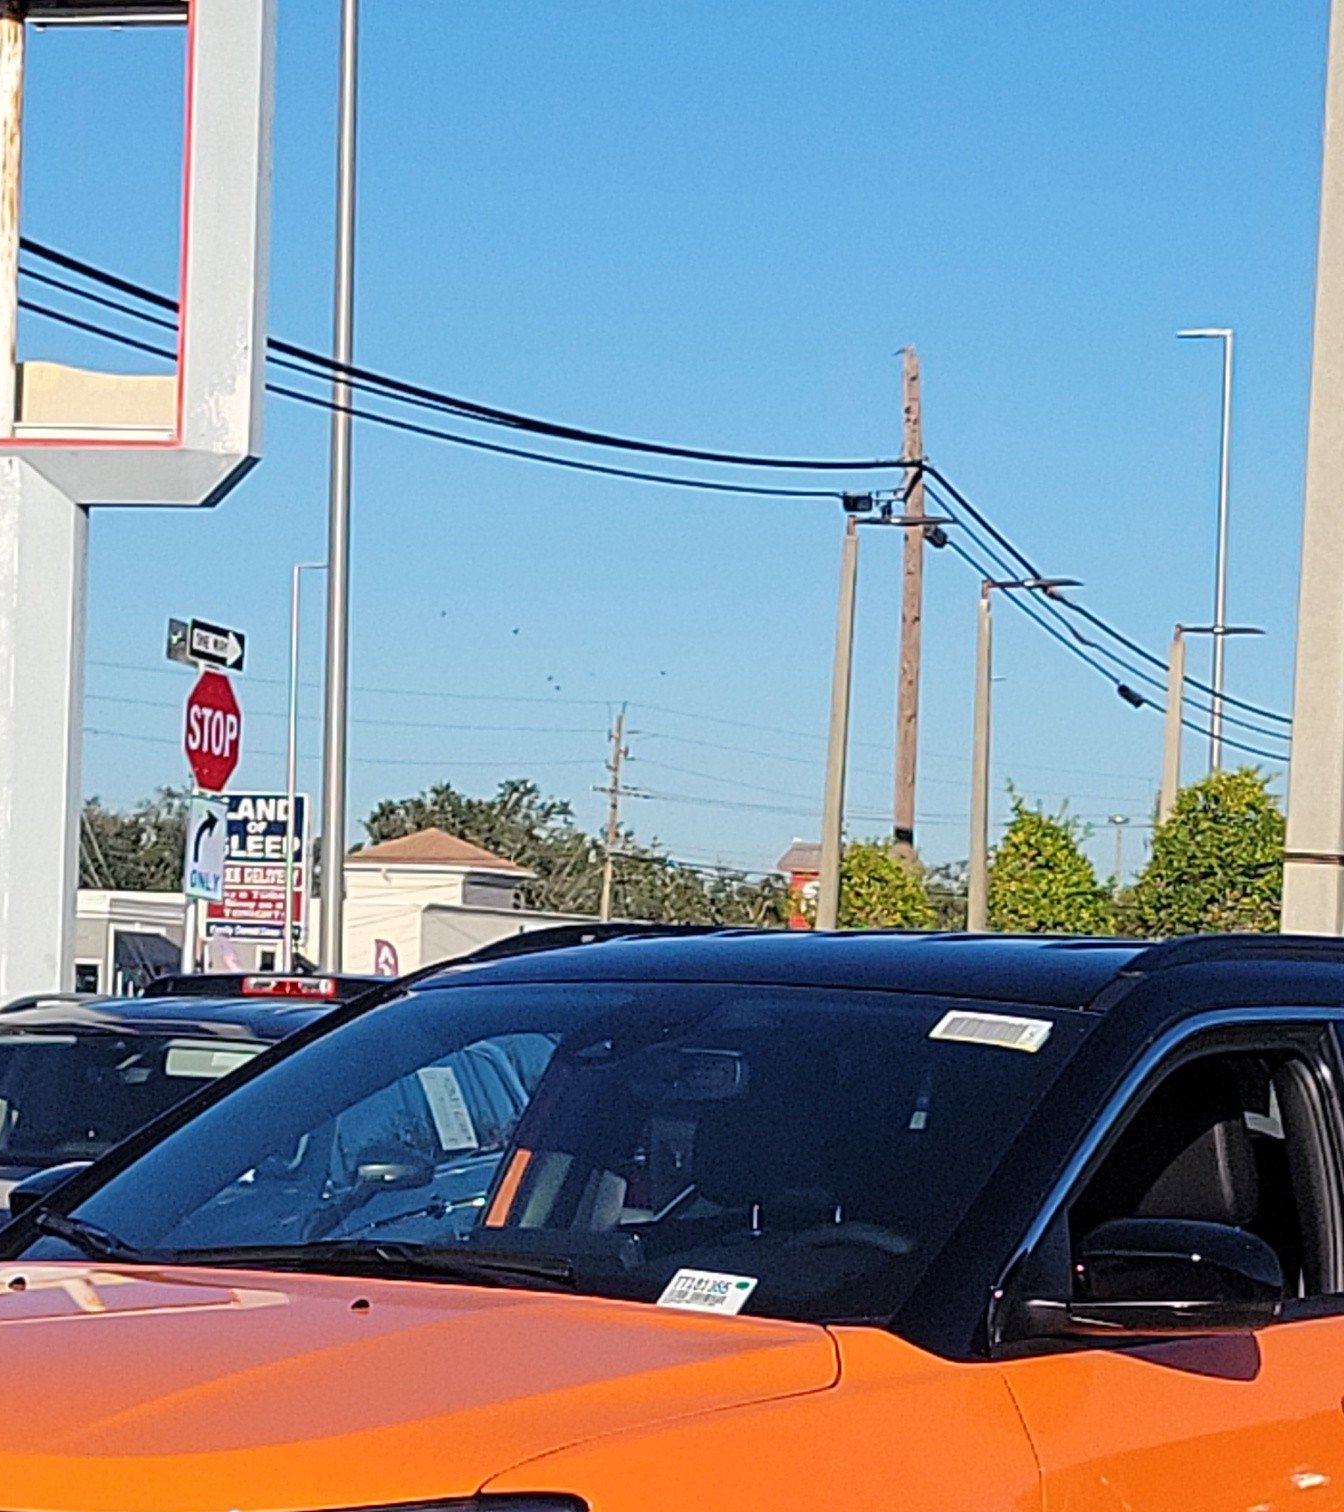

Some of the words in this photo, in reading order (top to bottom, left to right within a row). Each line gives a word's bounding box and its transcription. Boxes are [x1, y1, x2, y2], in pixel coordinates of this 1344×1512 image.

[188, 704, 238, 757] STOP
[225, 834, 301, 859] LEEP
[190, 868, 220, 892] ONLY
